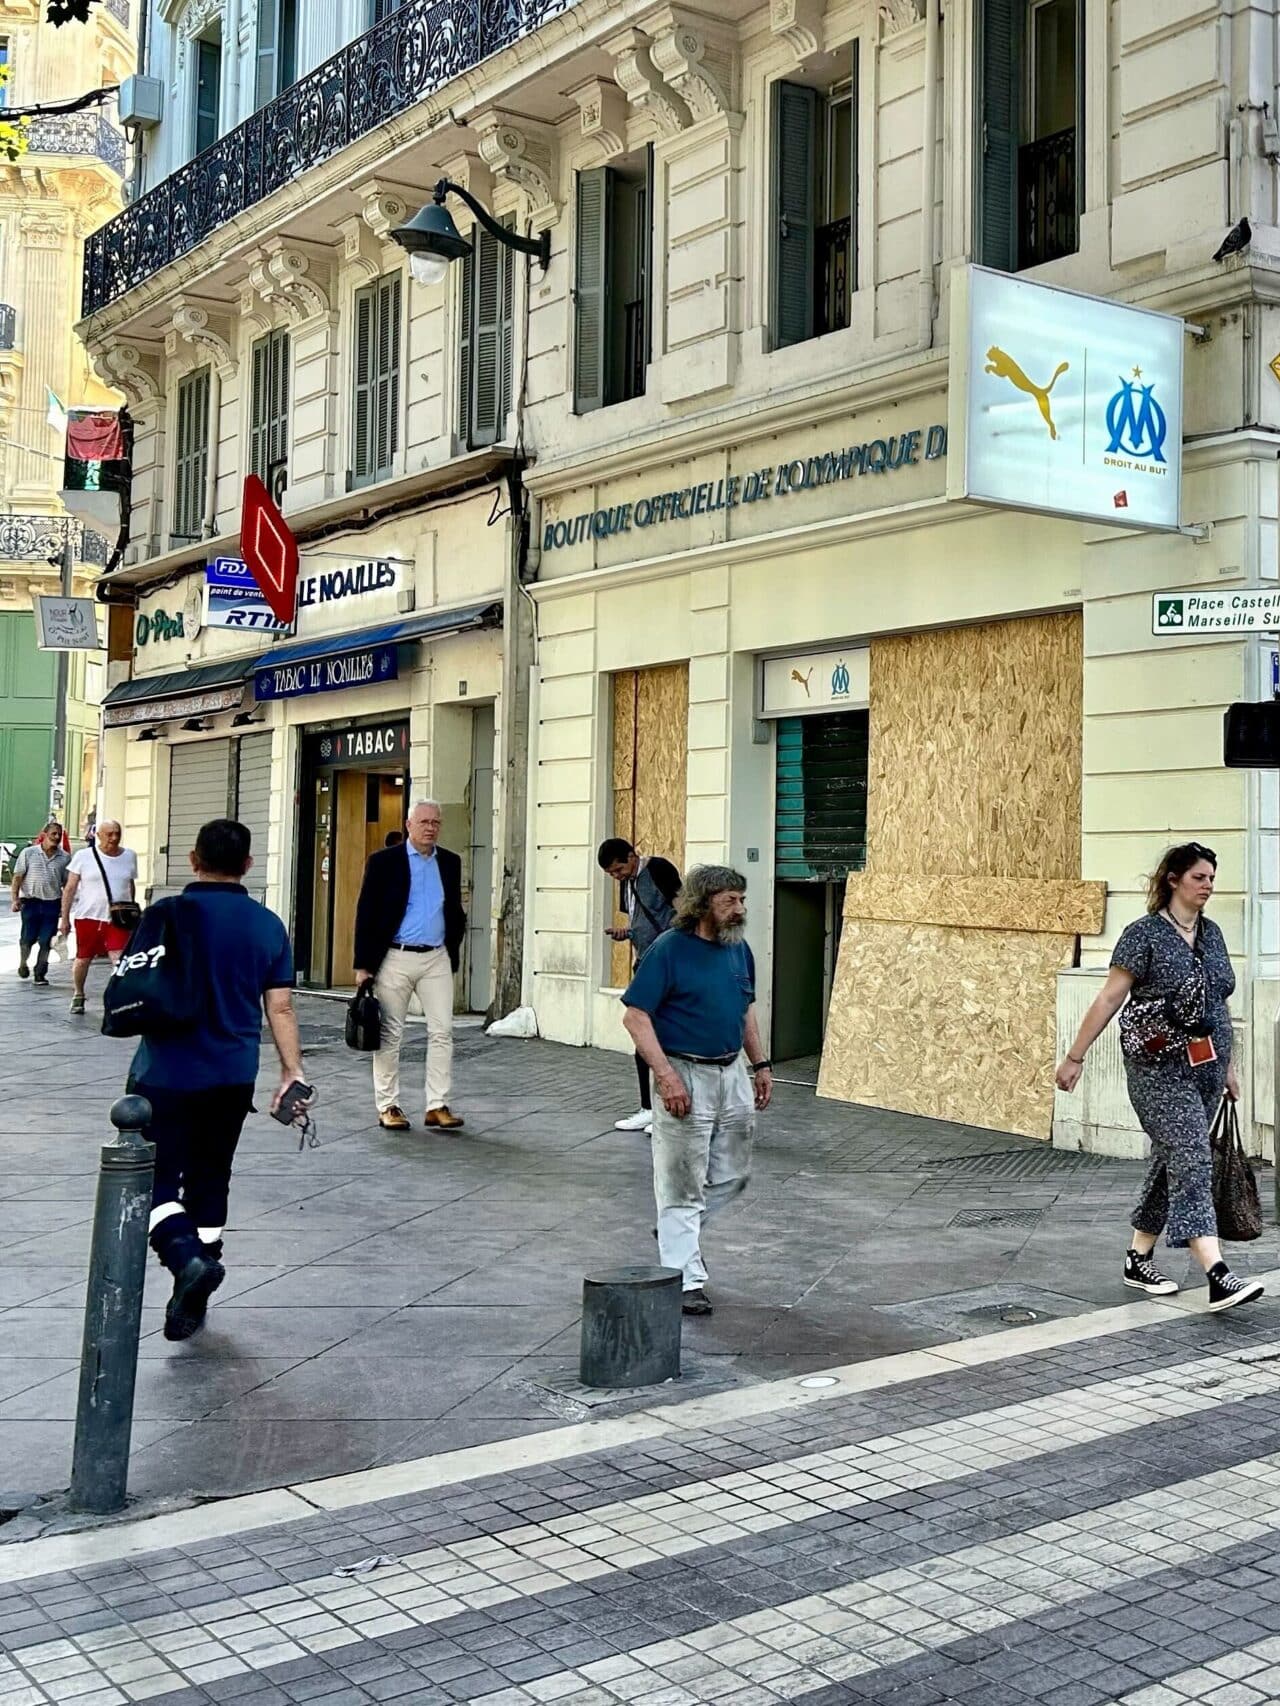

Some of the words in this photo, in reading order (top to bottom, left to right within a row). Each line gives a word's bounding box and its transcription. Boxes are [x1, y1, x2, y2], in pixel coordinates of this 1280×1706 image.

[1104, 457, 1131, 471] DROIT
[1134, 462, 1147, 472] AU
[1149, 464, 1168, 475] BUT
[544, 503, 632, 551] BOUTIQUE
[634, 476, 739, 528] OFFICIELLE
[742, 467, 772, 503] DE
[775, 430, 920, 496] L'OLYMPIQUE
[218, 561, 248, 575] FDJ
[210, 587, 232, 597] point
[233, 588, 243, 598] de
[298, 577, 316, 608] LE
[319, 560, 396, 604] NOAILLES
[1188, 597, 1224, 611] Place
[1188, 611, 1254, 627] Marseille
[274, 665, 306, 693] TABAC
[310, 663, 321, 687] LE
[326, 653, 373, 685] NOAILLES
[347, 728, 395, 756] TABAC
